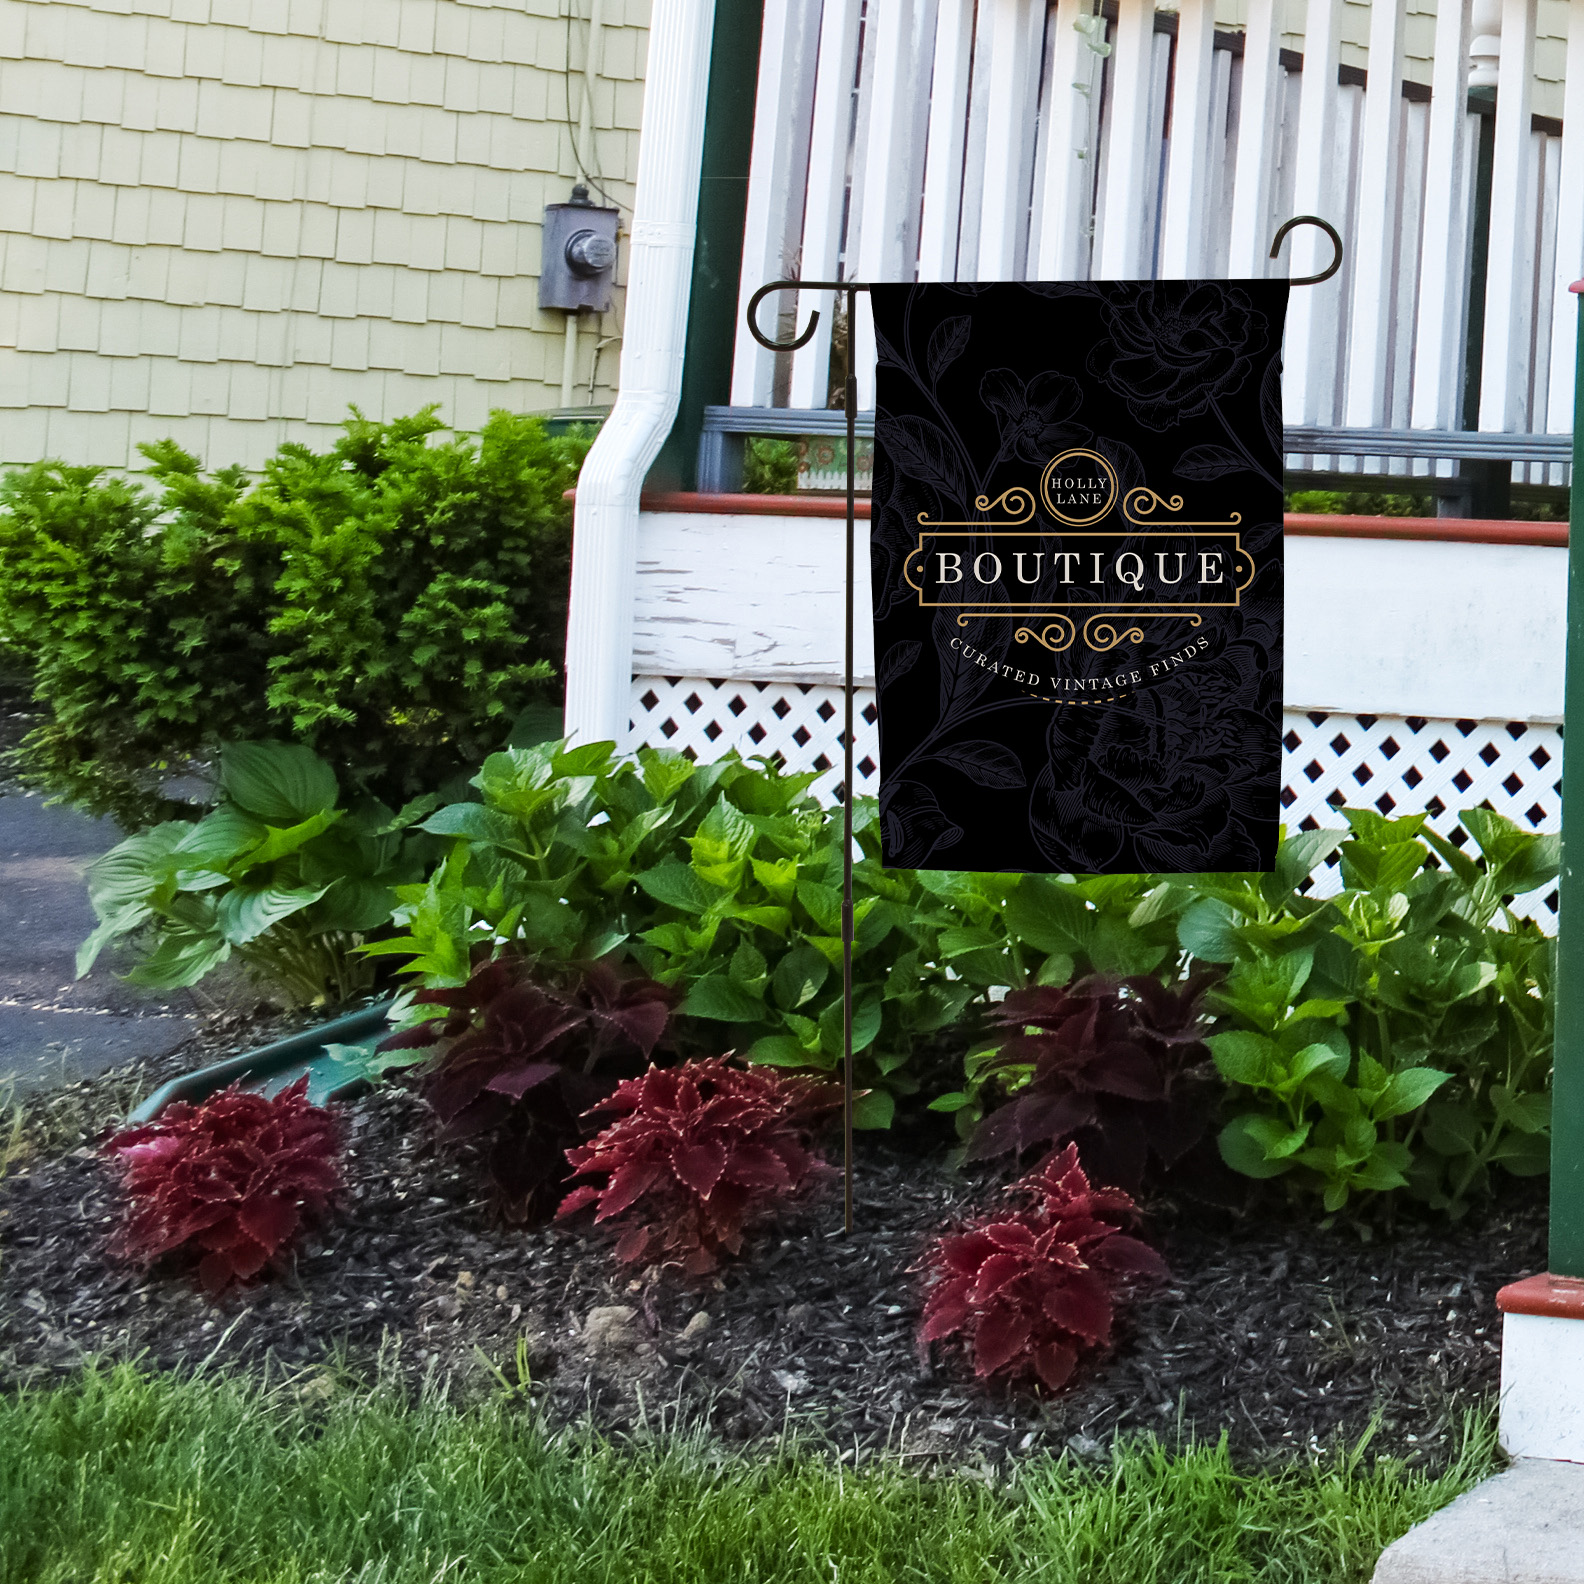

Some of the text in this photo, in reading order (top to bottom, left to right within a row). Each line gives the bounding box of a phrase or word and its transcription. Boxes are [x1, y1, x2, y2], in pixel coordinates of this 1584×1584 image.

[1051, 477, 1108, 490] HOLLY
[1056, 493, 1103, 505] LANE
[935, 551, 1225, 592] BOUTIQUE
[949, 636, 1210, 691] CURATED VINTAGE FINDS
